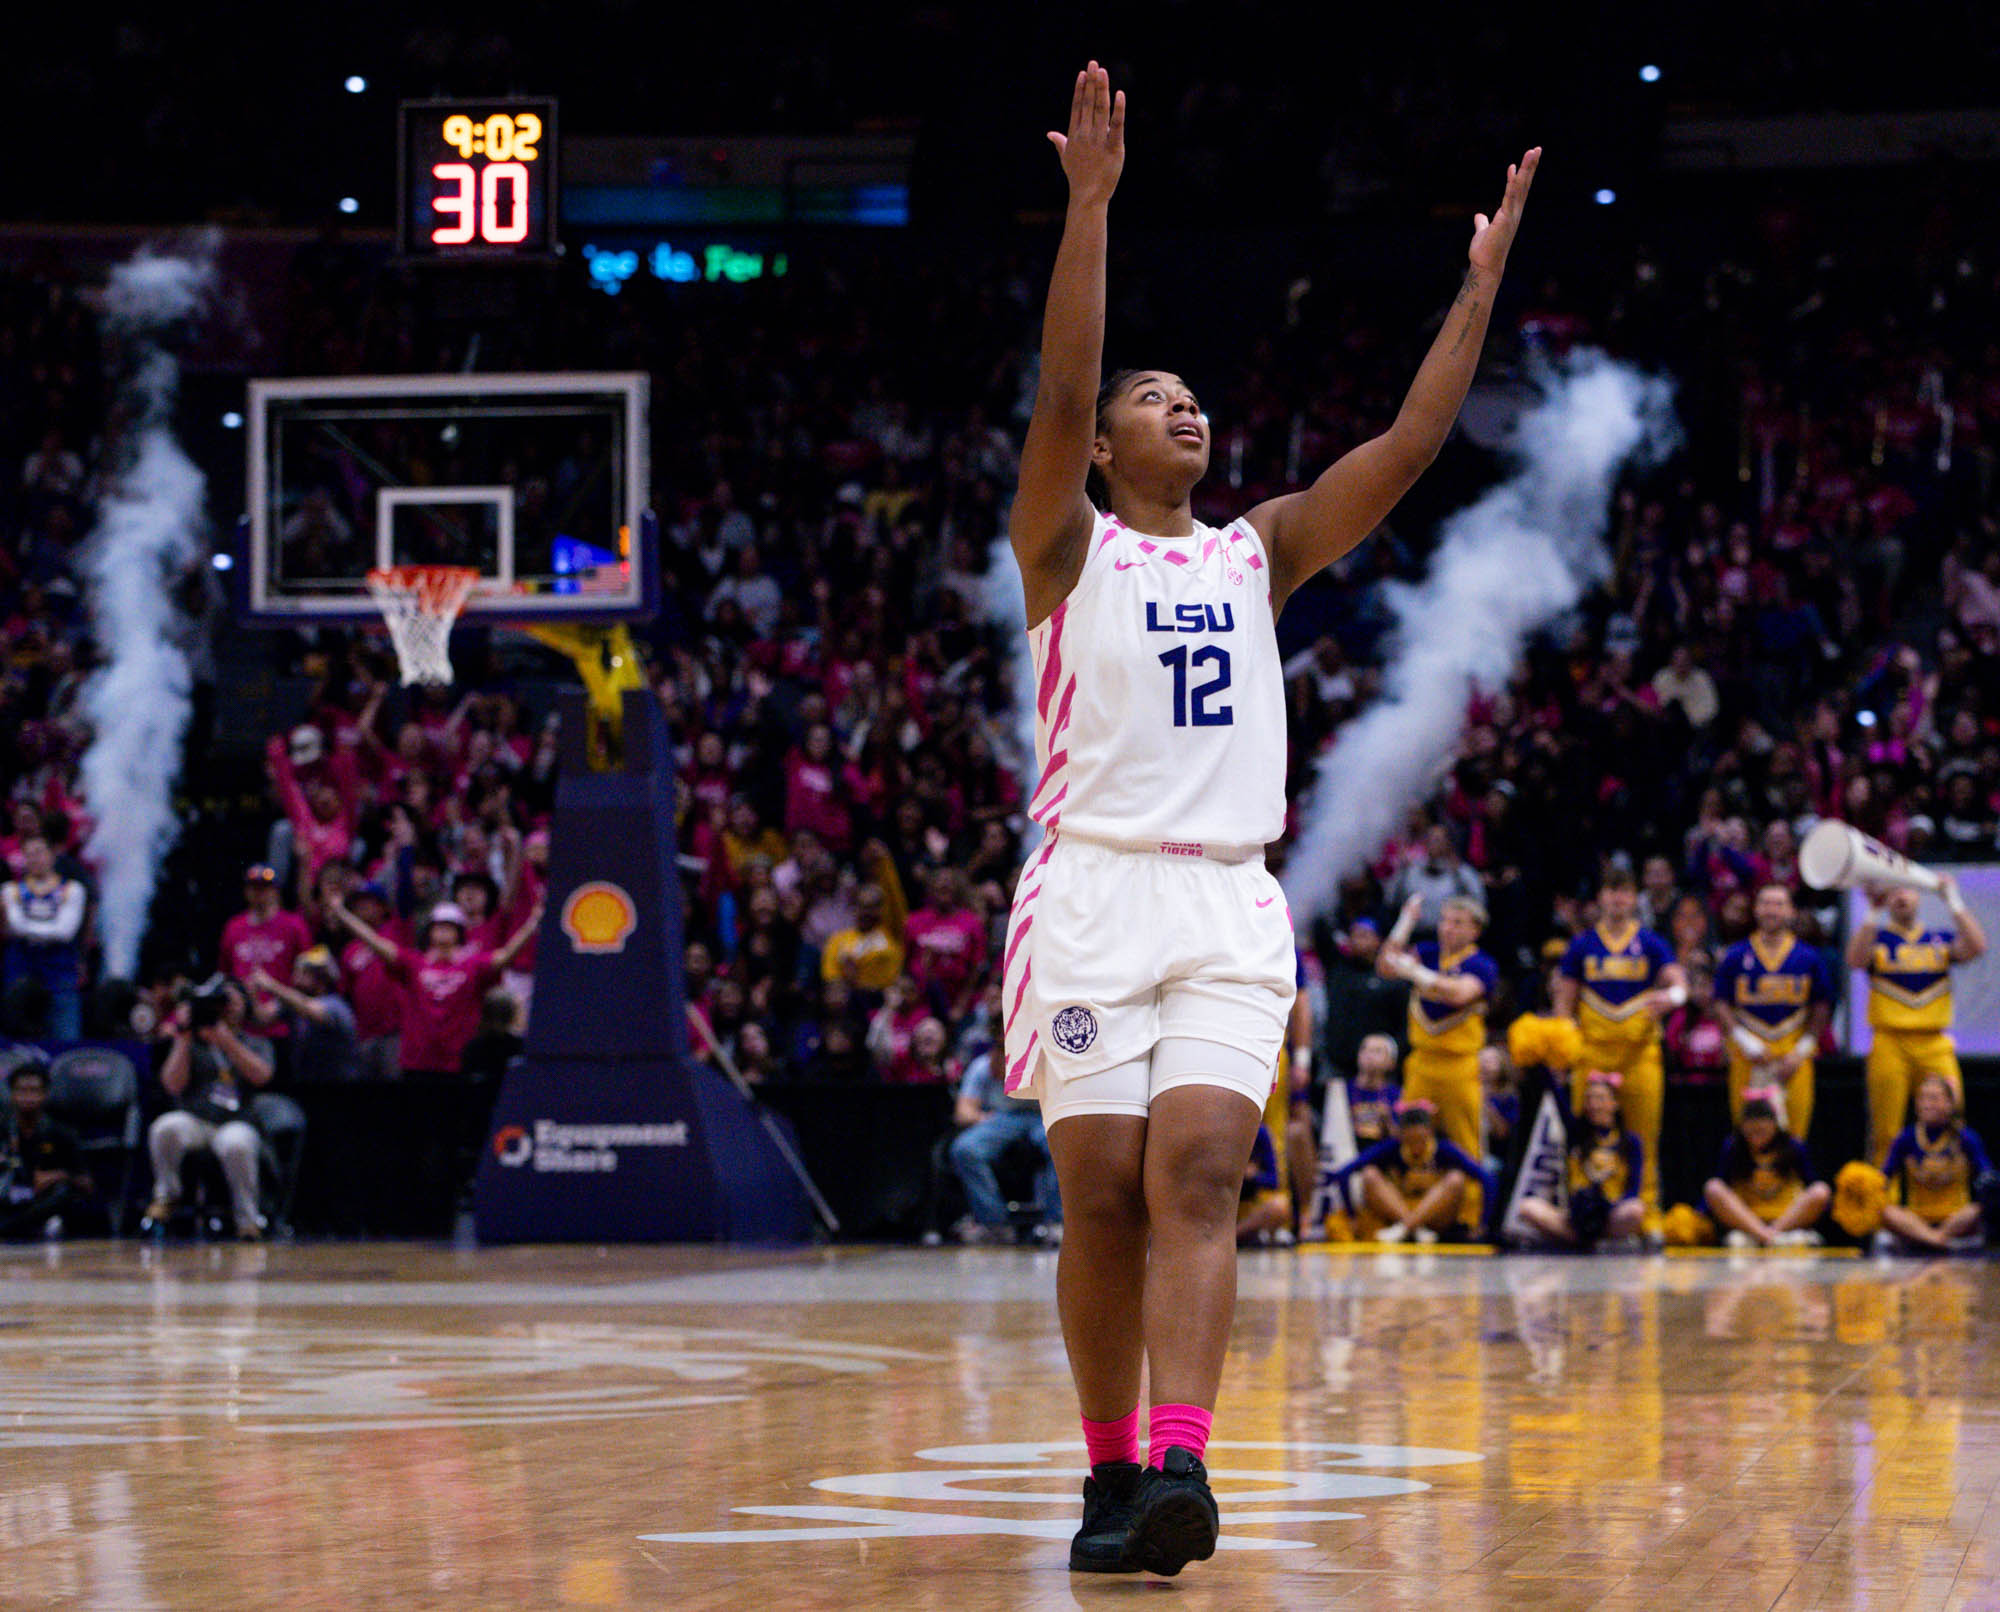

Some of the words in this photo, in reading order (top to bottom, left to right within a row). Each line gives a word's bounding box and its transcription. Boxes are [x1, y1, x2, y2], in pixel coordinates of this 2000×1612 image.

[443, 113, 542, 161] 9:02
[432, 162, 529, 244] 30
[1145, 601, 1235, 632] LSU
[1158, 644, 1234, 727] 12
[1160, 846, 1204, 857] TIGERS
